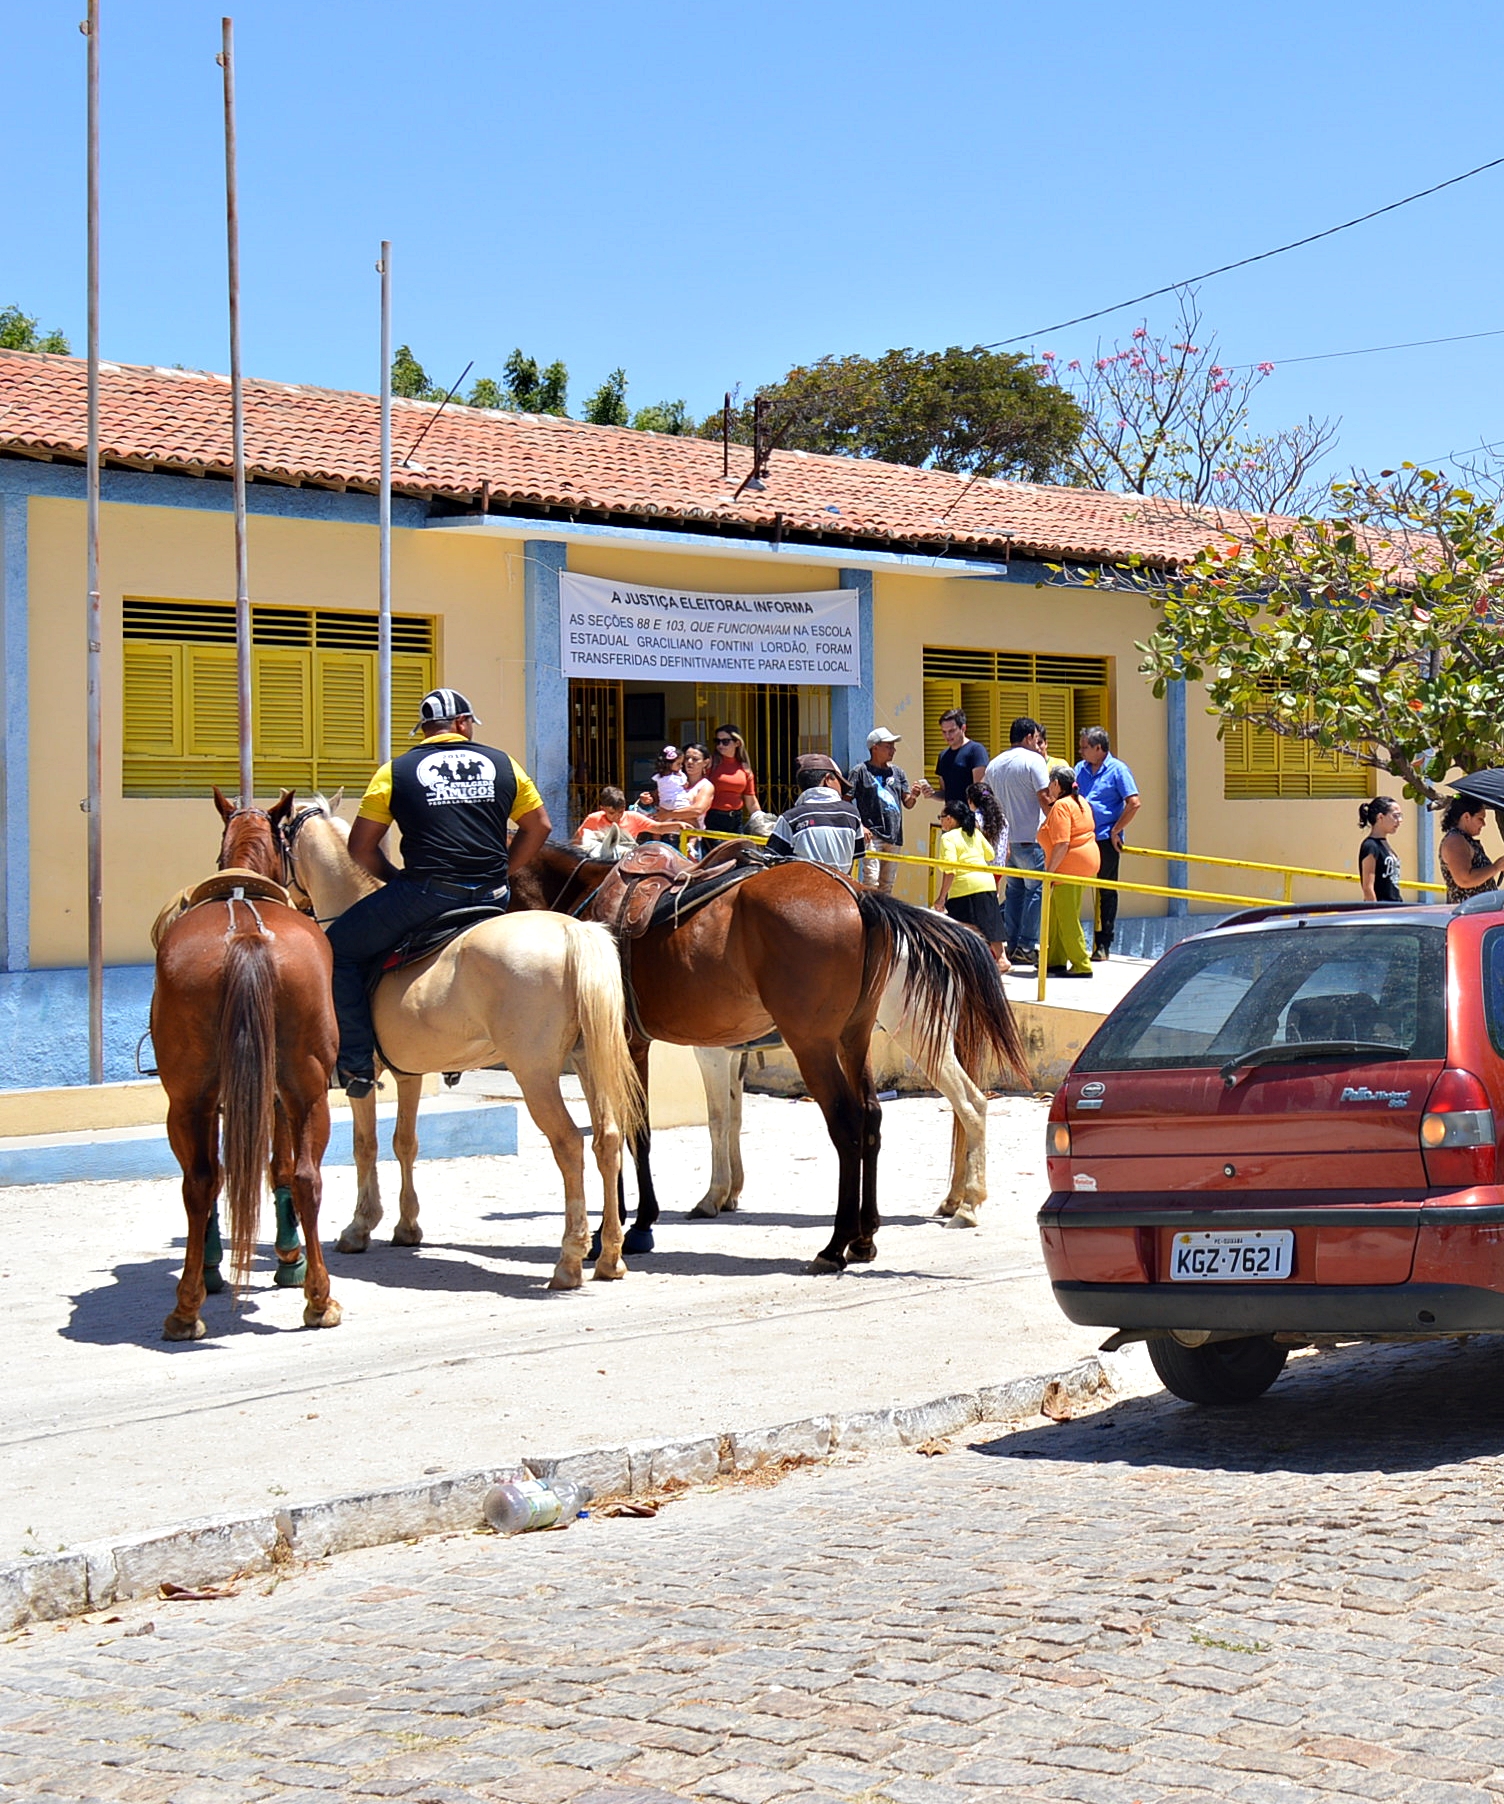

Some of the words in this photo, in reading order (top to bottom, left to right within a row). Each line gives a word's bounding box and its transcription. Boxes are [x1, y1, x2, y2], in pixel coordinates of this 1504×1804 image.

[611, 591, 622, 604] A
[625, 592, 679, 611] JUSTIÇA
[681, 596, 752, 613] ELEITORAL
[755, 601, 813, 614] INFORMA
[569, 614, 585, 626] AS
[587, 613, 634, 629] SEÇÕES
[637, 617, 650, 630] 88
[653, 619, 662, 630] E
[665, 620, 687, 633] 103,
[690, 621, 715, 633] QUE
[717, 622, 791, 636] FUNCIONAVAM
[793, 625, 809, 636] NA
[811, 626, 852, 638] ESCOLA
[570, 632, 630, 647] ESTADUAL
[637, 636, 703, 650] GRACILIANO
[710, 640, 754, 652] FONTINI
[760, 640, 809, 655] LORDÃO,
[816, 643, 852, 655] FORAM
[570, 651, 657, 667] TRANSFERIDAS
[660, 655, 755, 670] DEFINITIVAMENTE
[758, 659, 786, 671] PARA
[788, 659, 815, 672] ESTE
[818, 660, 852, 673] LOCAL.
